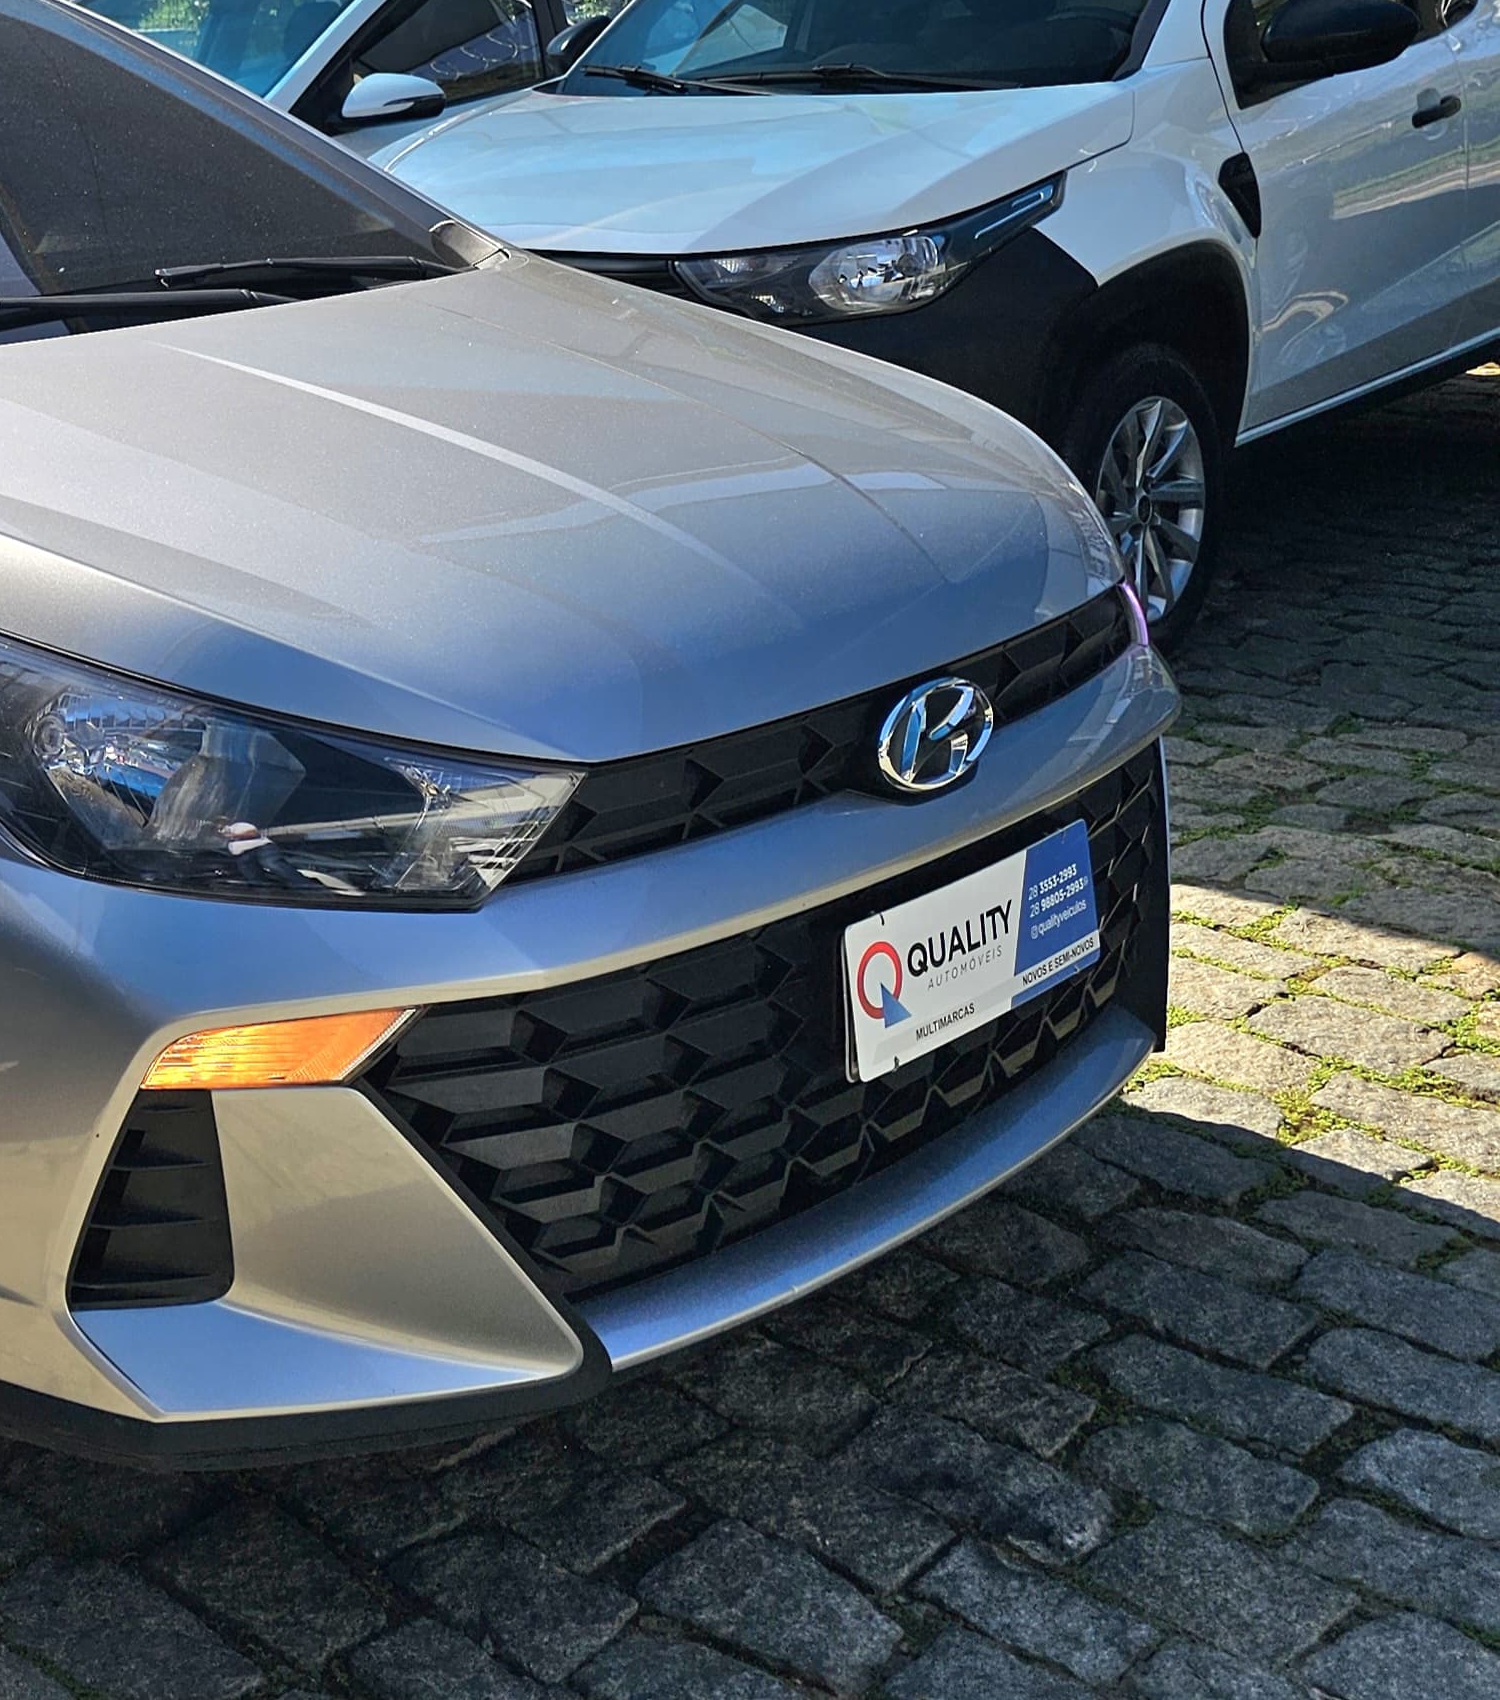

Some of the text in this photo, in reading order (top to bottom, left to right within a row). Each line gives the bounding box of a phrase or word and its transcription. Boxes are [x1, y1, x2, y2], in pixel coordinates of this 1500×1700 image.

[1028, 885, 1039, 901] 28
[1029, 902, 1040, 918] 28
[907, 899, 1012, 978] QUALITY
[1022, 966, 1047, 986] NOVOS
[1054, 937, 1094, 968] SEMI-NOVOS
[915, 1003, 975, 1041] MULTIMARCAS
